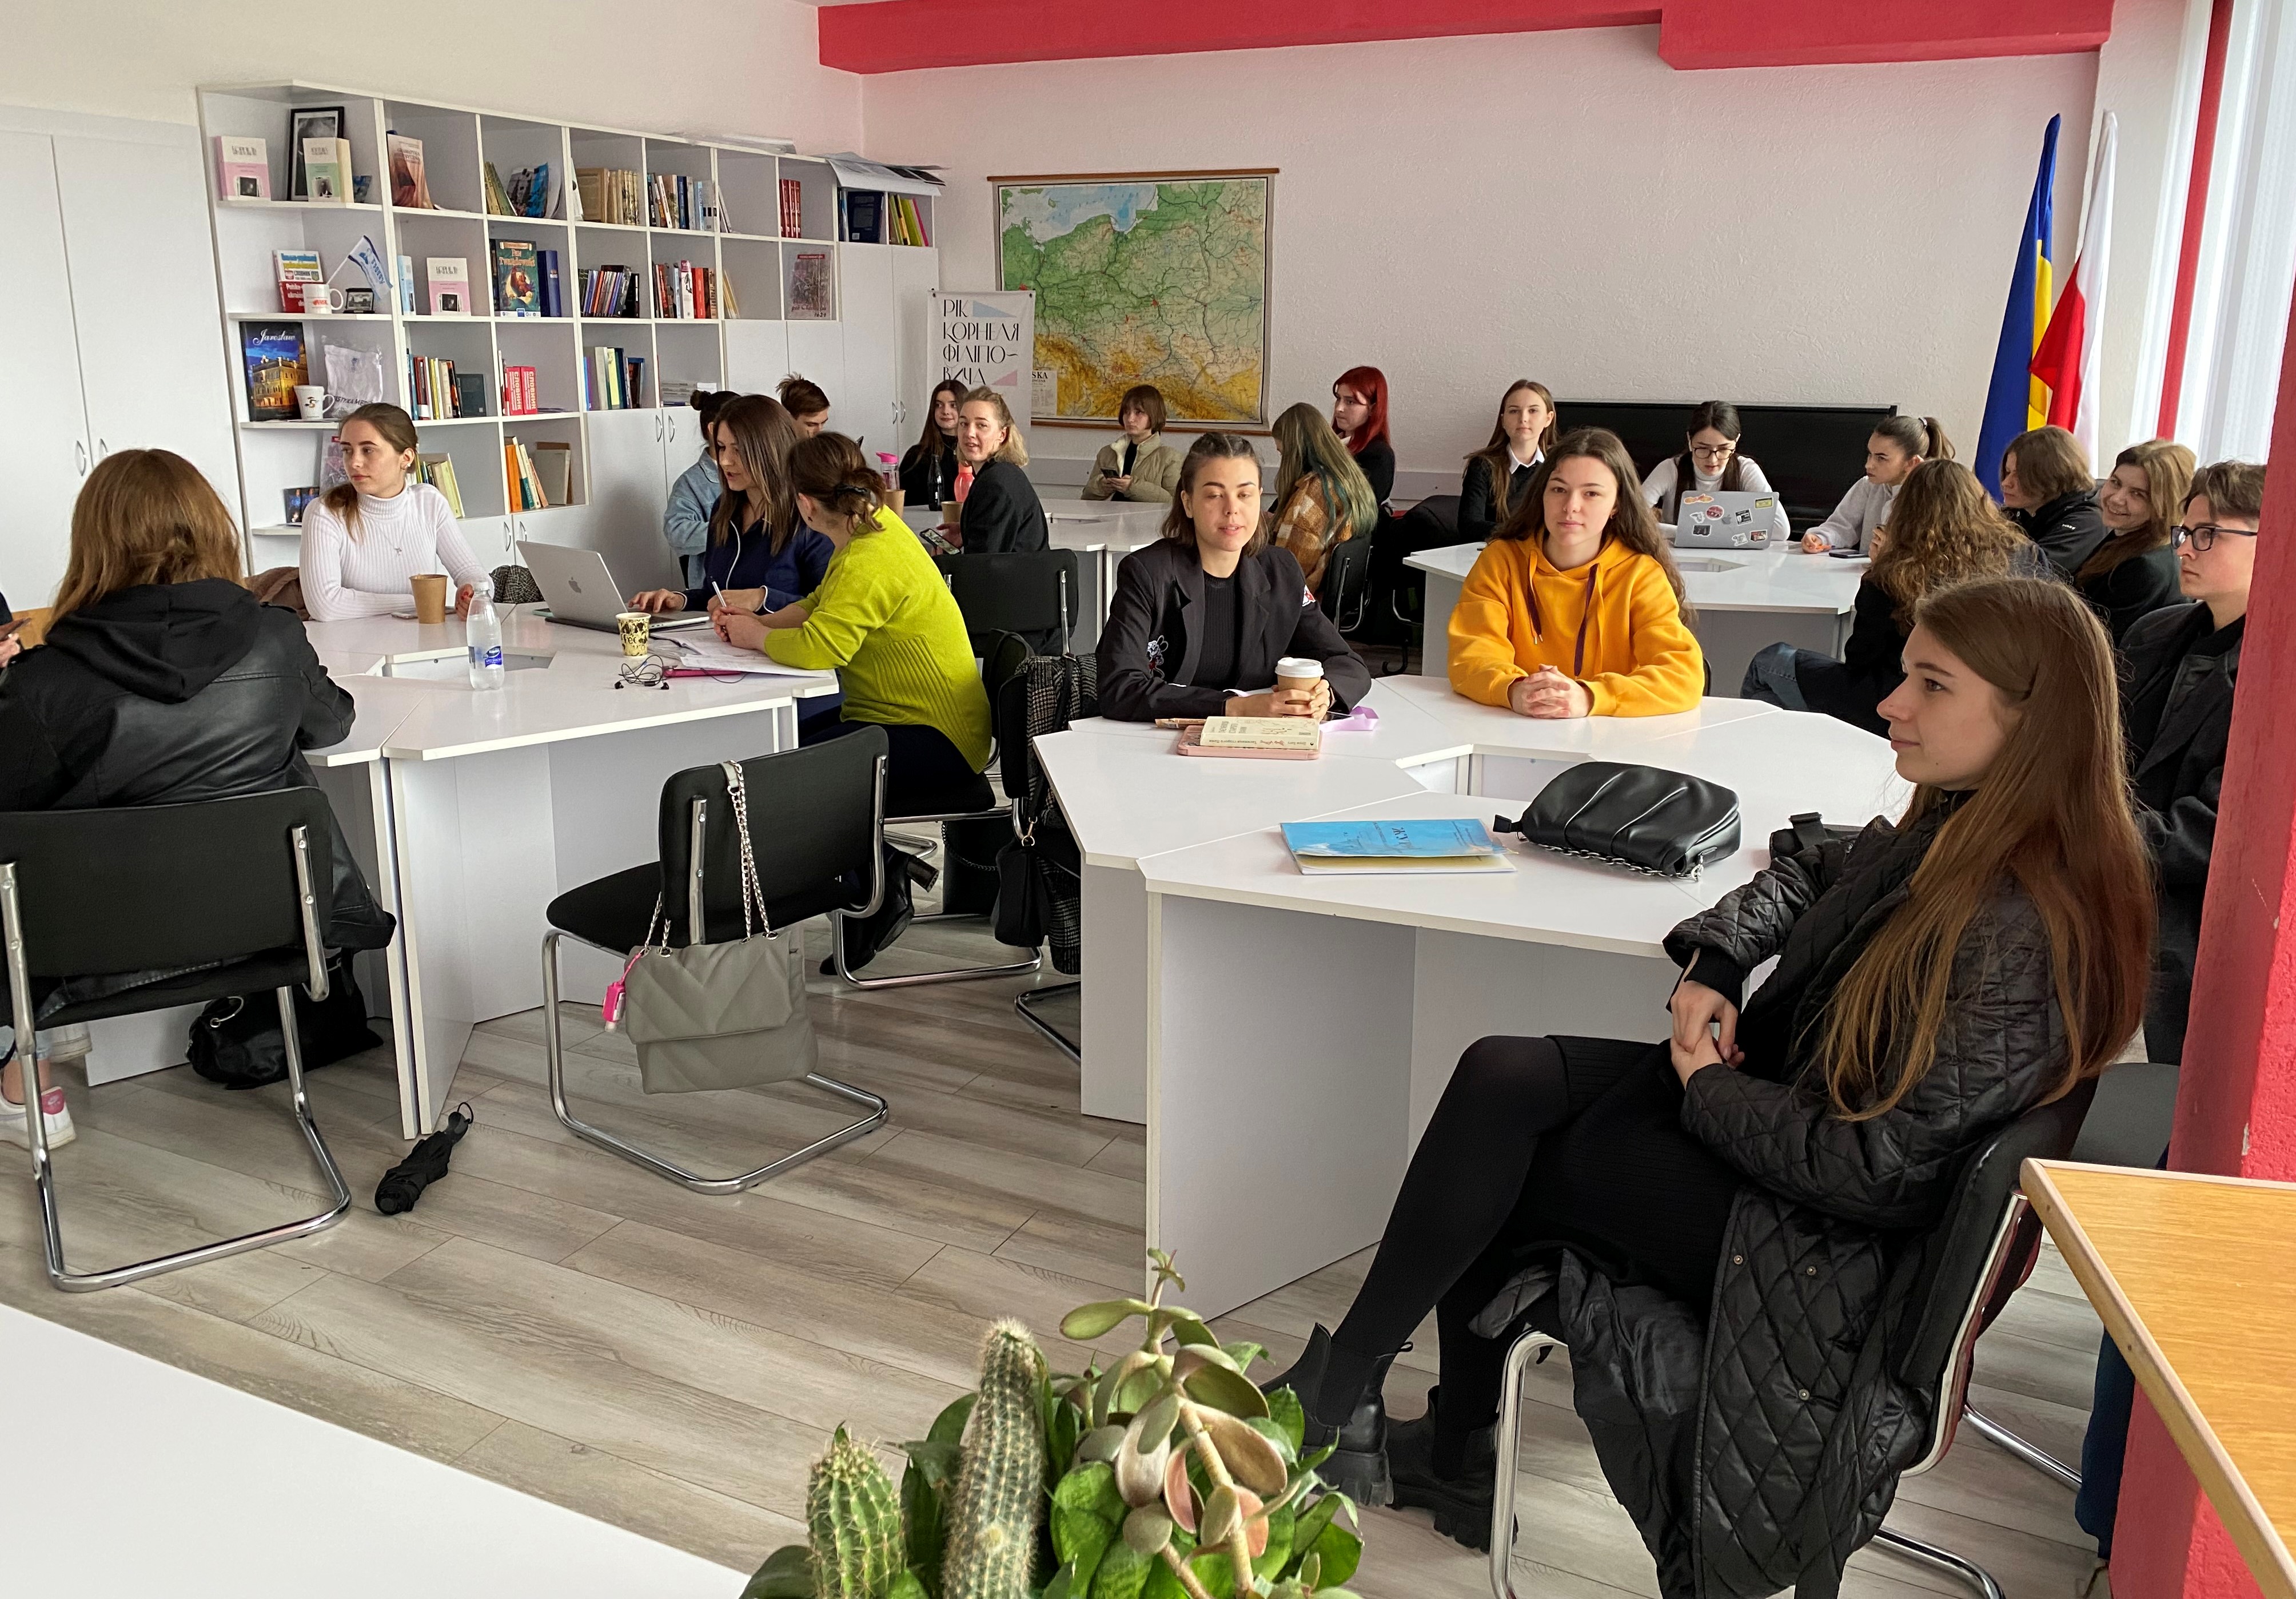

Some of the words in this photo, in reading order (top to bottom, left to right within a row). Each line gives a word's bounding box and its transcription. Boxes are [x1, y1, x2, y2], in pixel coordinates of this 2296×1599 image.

[943, 299, 969, 317] РІК
[943, 322, 1019, 343] КОРНЕЛЯ
[943, 367, 986, 385] ВИЧА
